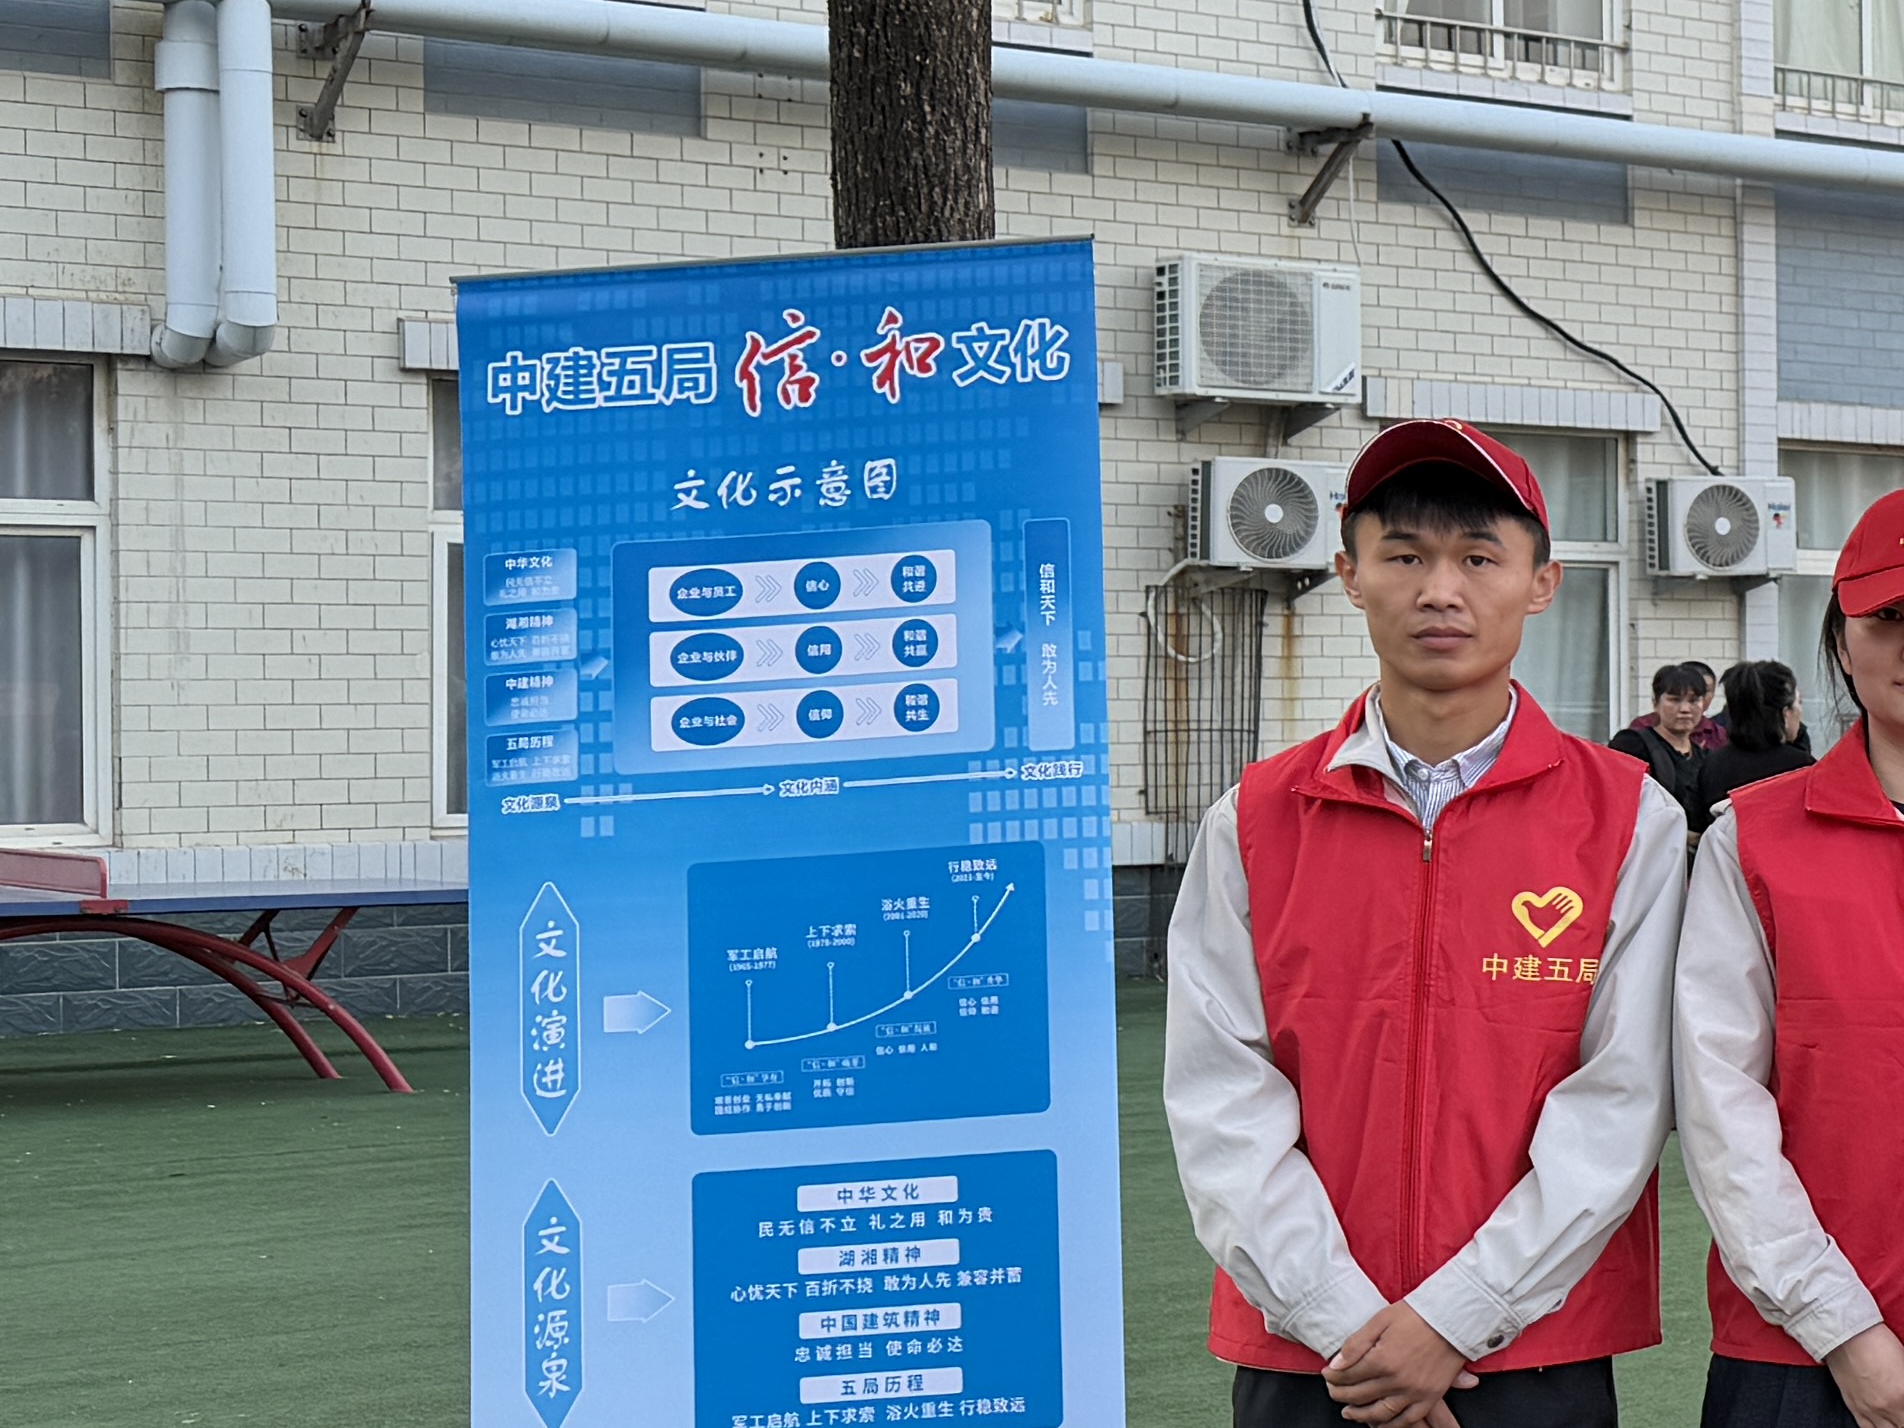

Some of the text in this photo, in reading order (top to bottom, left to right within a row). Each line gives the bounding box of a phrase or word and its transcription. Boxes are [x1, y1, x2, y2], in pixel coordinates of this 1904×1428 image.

[670, 458, 898, 511] 文化示意图
[504, 555, 553, 570] 中华文化
[676, 585, 737, 600] 企业与员工
[805, 579, 830, 592] 信心
[902, 580, 926, 593] 共进
[1039, 563, 1056, 626] 信和天下
[677, 649, 737, 664] 企业与伙伴
[807, 644, 832, 657] 信用
[1041, 643, 1058, 706] 敢为人先
[679, 715, 738, 729] 企业与社会
[808, 708, 833, 722] 信仰
[905, 709, 930, 722] 共生
[506, 735, 554, 750] 五局历程
[1021, 761, 1083, 781] 文化践行
[779, 777, 840, 797] 文化内涵
[501, 794, 561, 814] 文化源泉
[948, 858, 997, 873] 行稳致远
[881, 896, 930, 912] 浴火重生
[805, 923, 857, 938] 上下求索
[727, 947, 778, 961] 军工启航
[1482, 952, 1600, 985] 中建五局
[530, 918, 569, 1099] 文化演进
[836, 1183, 920, 1204] 中华文化
[758, 1206, 994, 1238] 民无信不立 礼之用 和为贵
[838, 1245, 922, 1267] 湖湘精神
[730, 1266, 1022, 1302] 心忧天下 百折不挠 敢为人先 兼容并蓄
[533, 1215, 572, 1399] 文化源泉
[820, 1308, 941, 1333] 中国建筑精神
[794, 1336, 964, 1363] 忠诚担当 使命必达
[840, 1374, 924, 1396] 五局历程
[806, 1406, 876, 1426] 上下求索
[886, 1400, 954, 1422] 浴火重生
[959, 1396, 1026, 1417] 行稳致远
